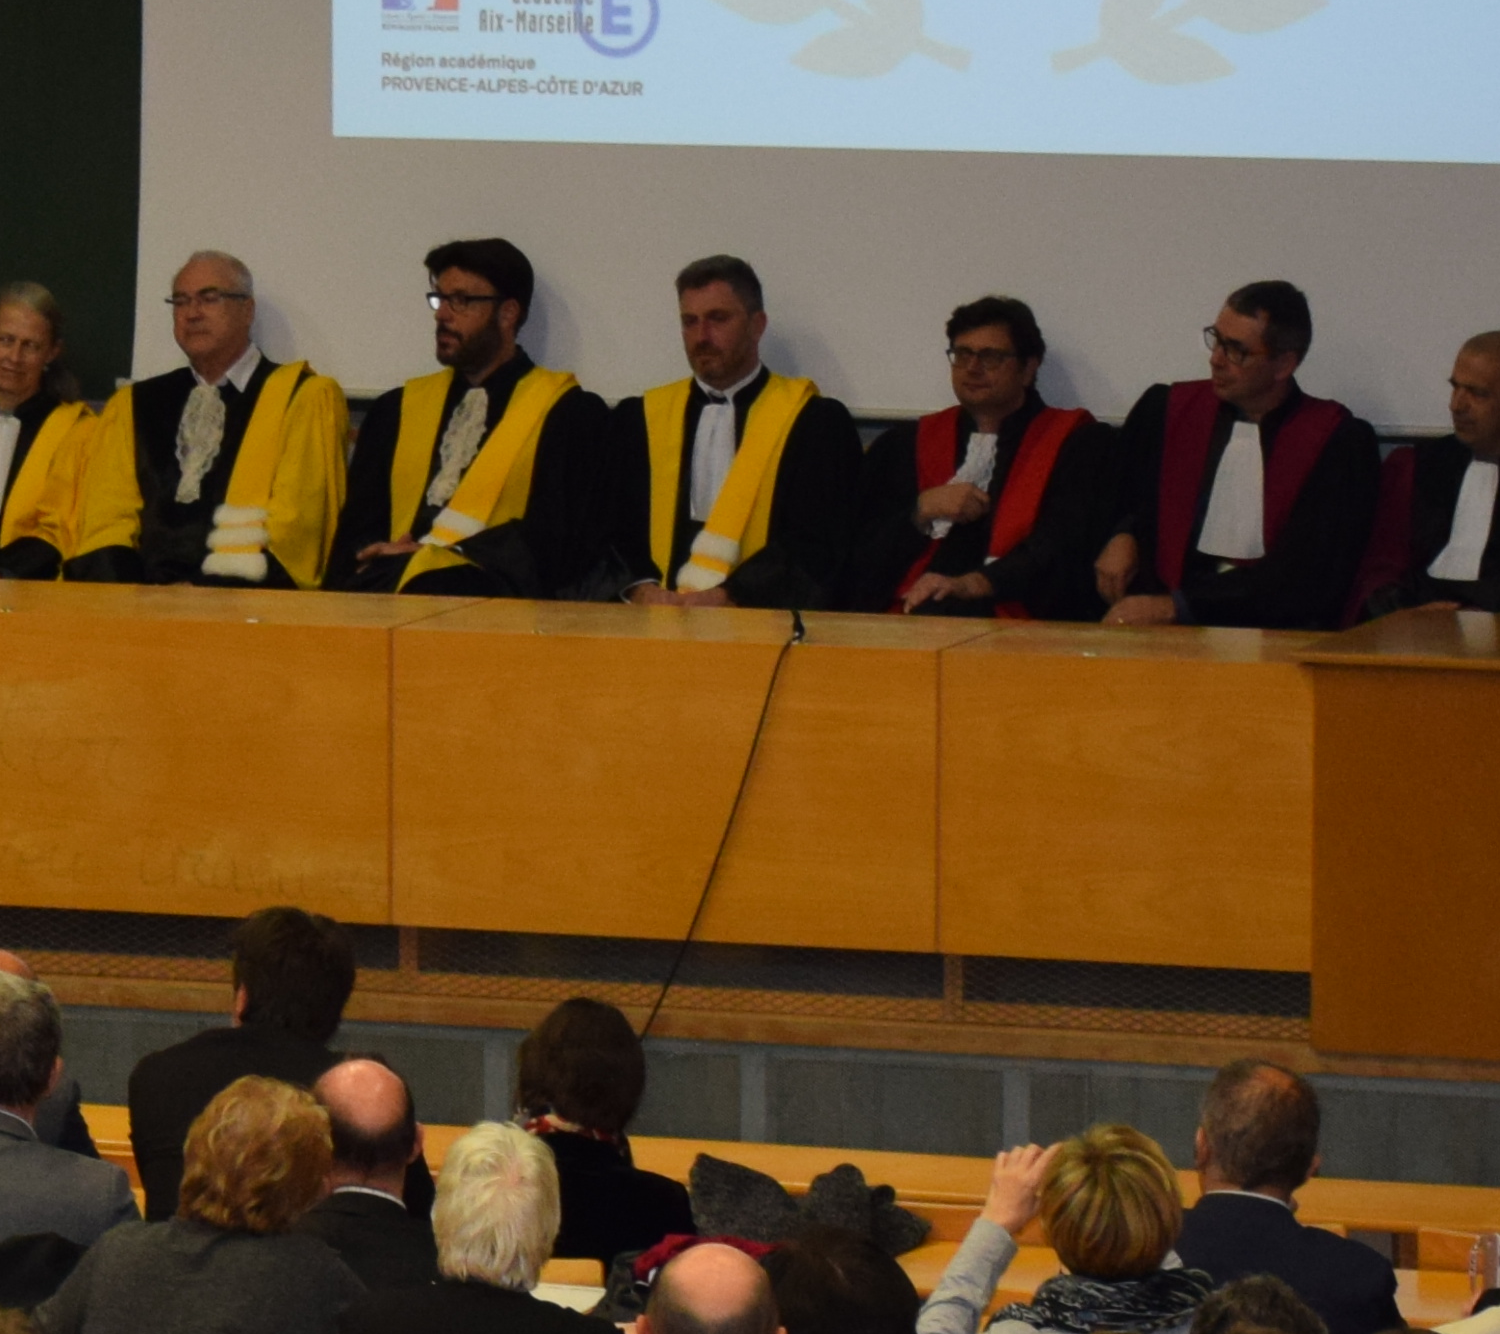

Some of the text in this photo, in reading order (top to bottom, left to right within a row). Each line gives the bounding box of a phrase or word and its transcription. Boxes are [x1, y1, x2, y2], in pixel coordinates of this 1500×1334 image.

[478, 10, 595, 34] Aix-Marseille
[381, 52, 537, 73] Région académique
[381, 75, 644, 96] PROVENCE-ALPES-CÔTE D'AZUR
